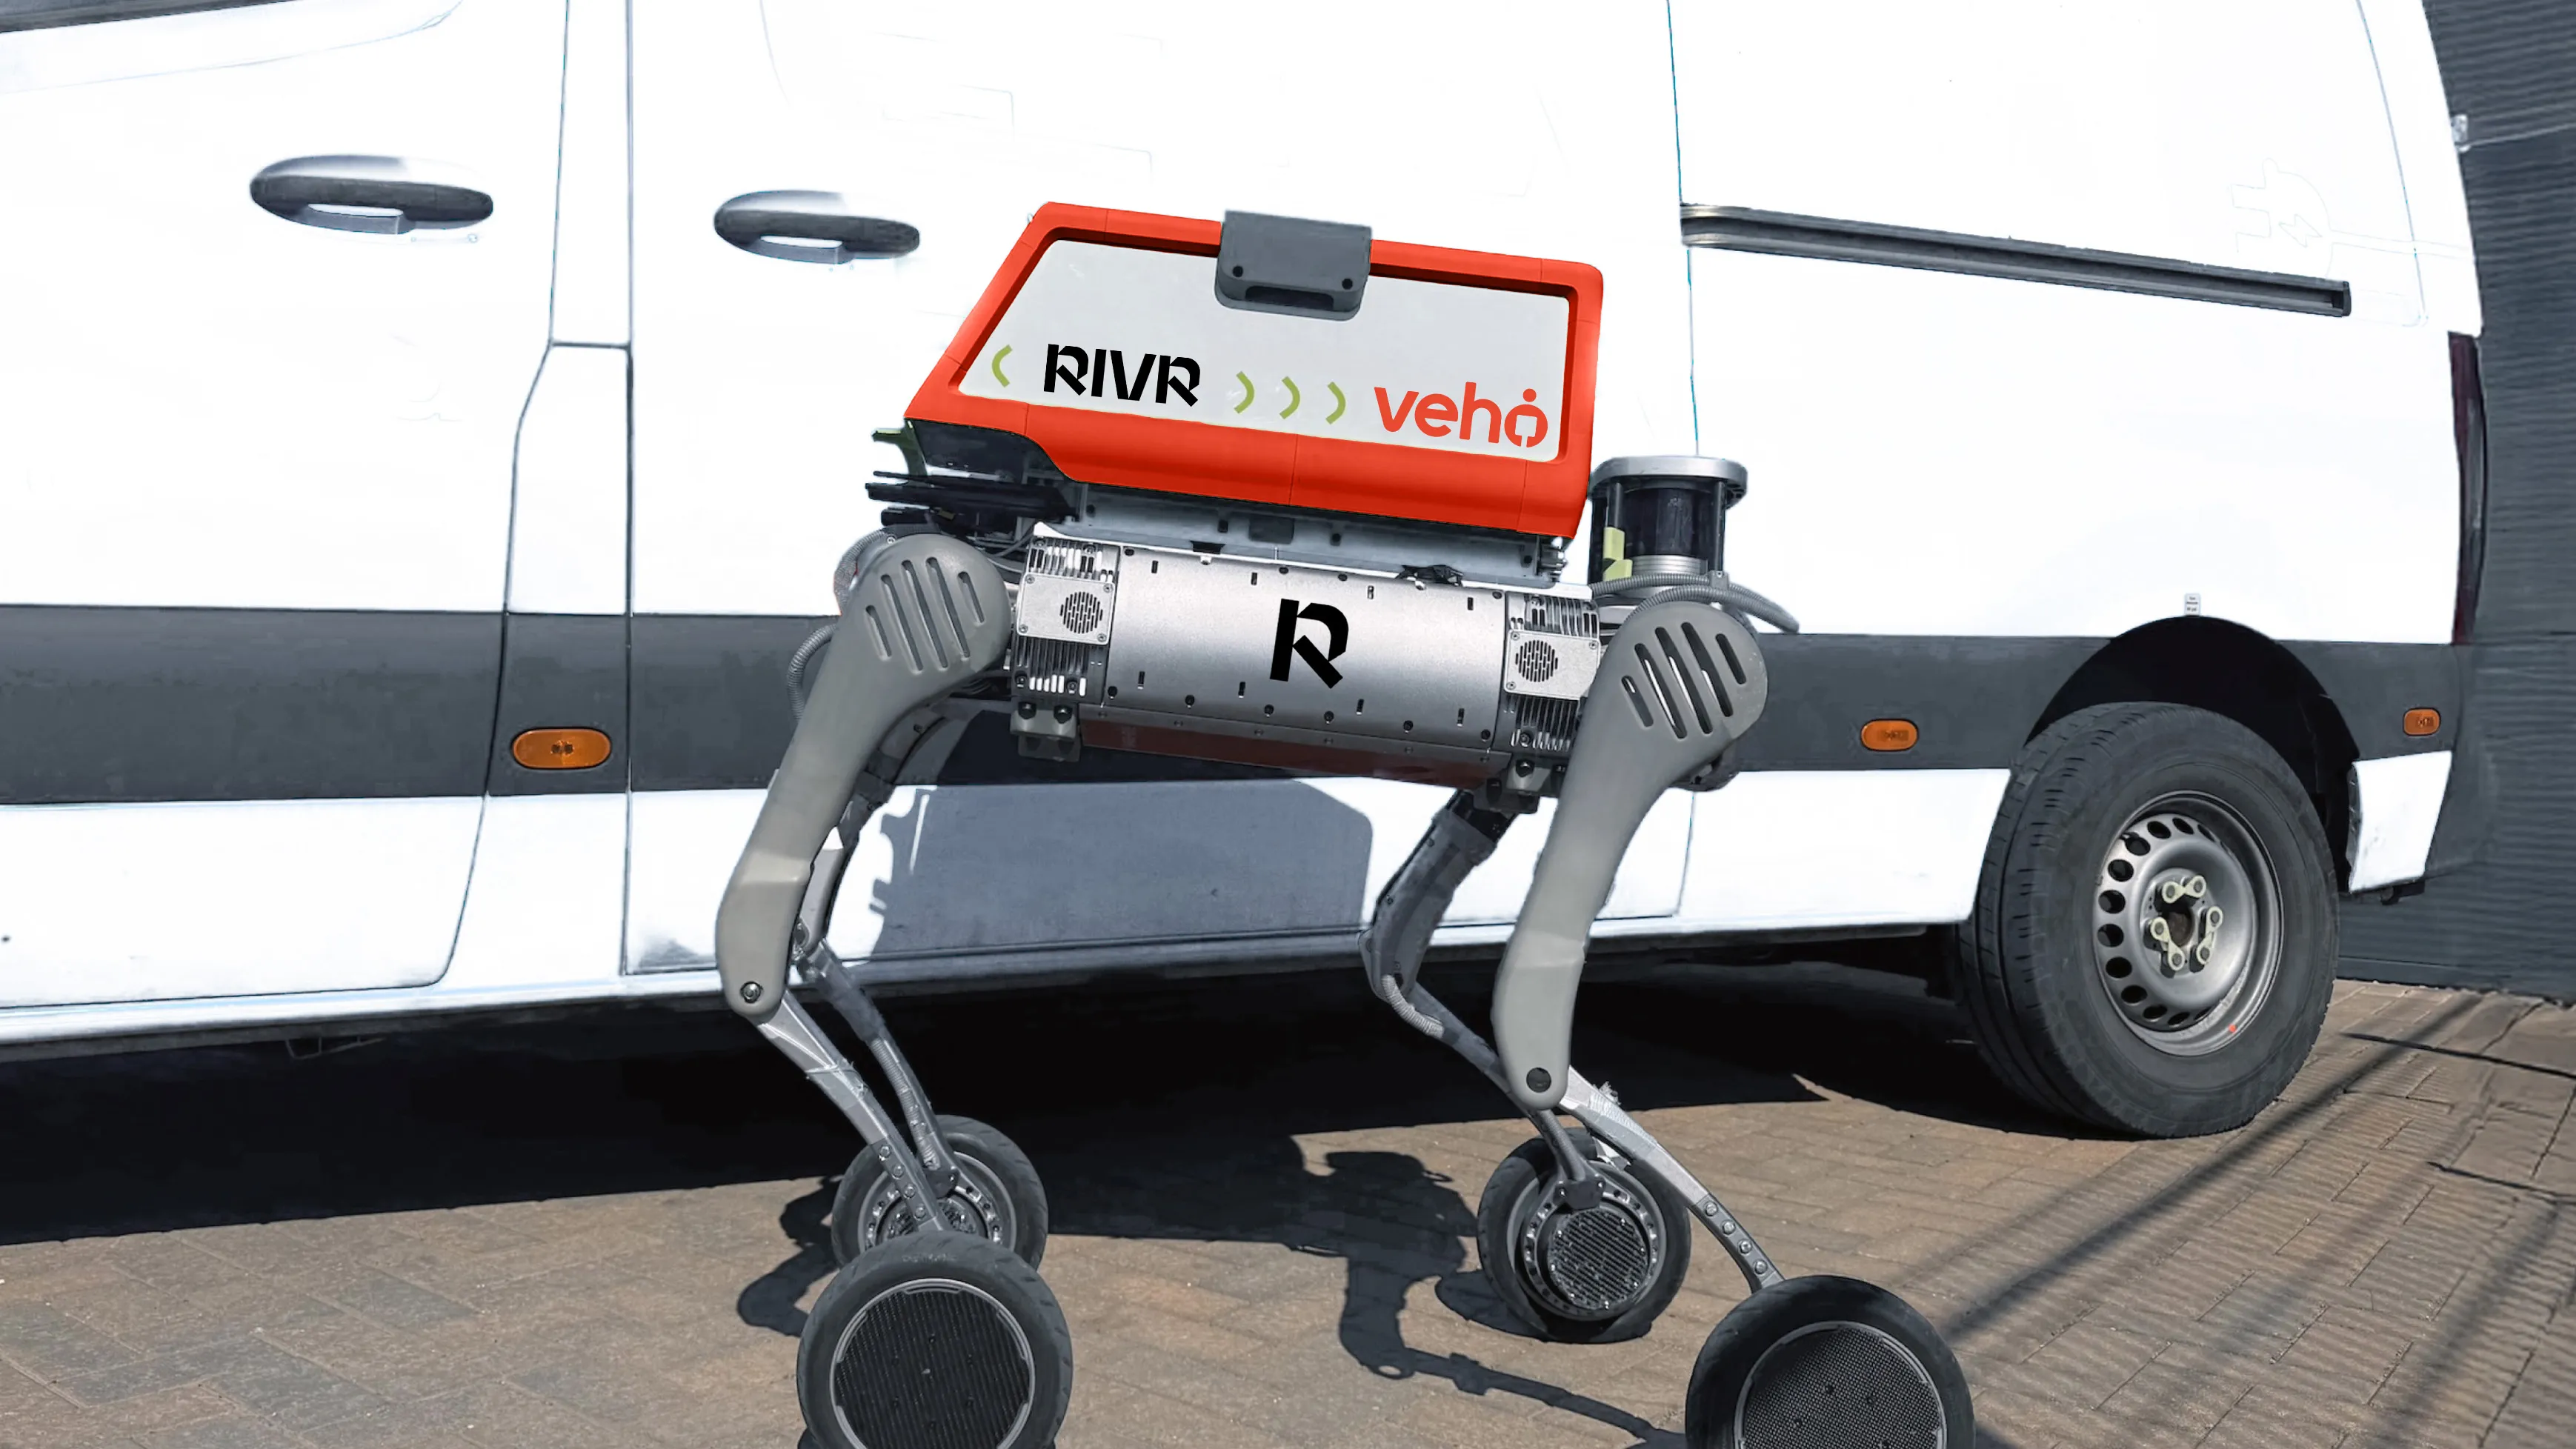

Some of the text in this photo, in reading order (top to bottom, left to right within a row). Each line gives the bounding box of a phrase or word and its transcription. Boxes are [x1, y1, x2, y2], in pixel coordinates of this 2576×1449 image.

[1043, 343, 1548, 448] RIVR veho
[1269, 599, 1350, 690] R
